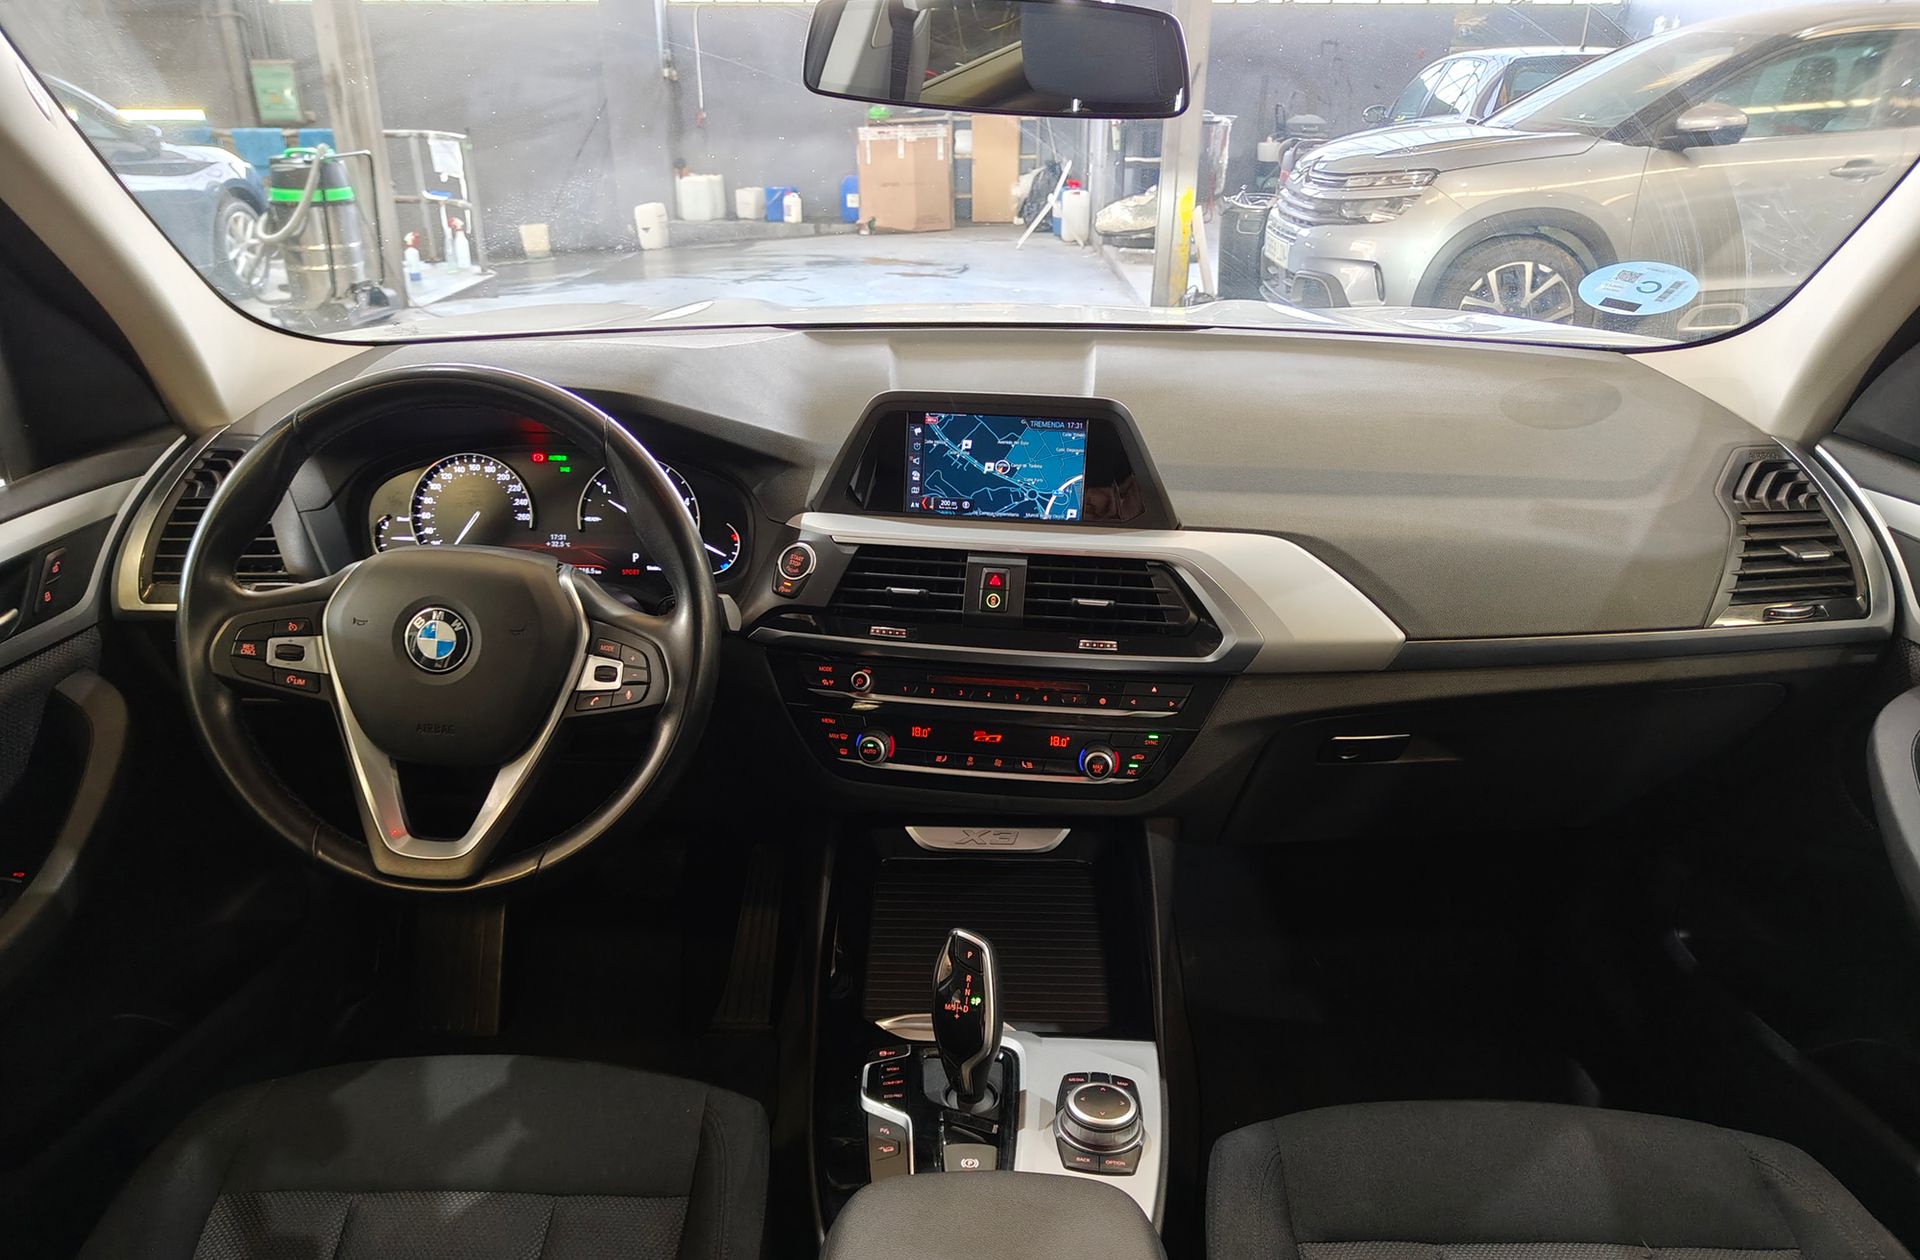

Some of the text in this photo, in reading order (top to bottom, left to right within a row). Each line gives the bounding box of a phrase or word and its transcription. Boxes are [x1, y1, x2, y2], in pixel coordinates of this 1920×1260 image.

[602, 484, 606, 494] 1
[632, 553, 640, 563] P
[413, 610, 464, 632] BMW
[600, 644, 616, 652] MODE
[956, 830, 1020, 846] X3
[962, 1004, 969, 1013] D
